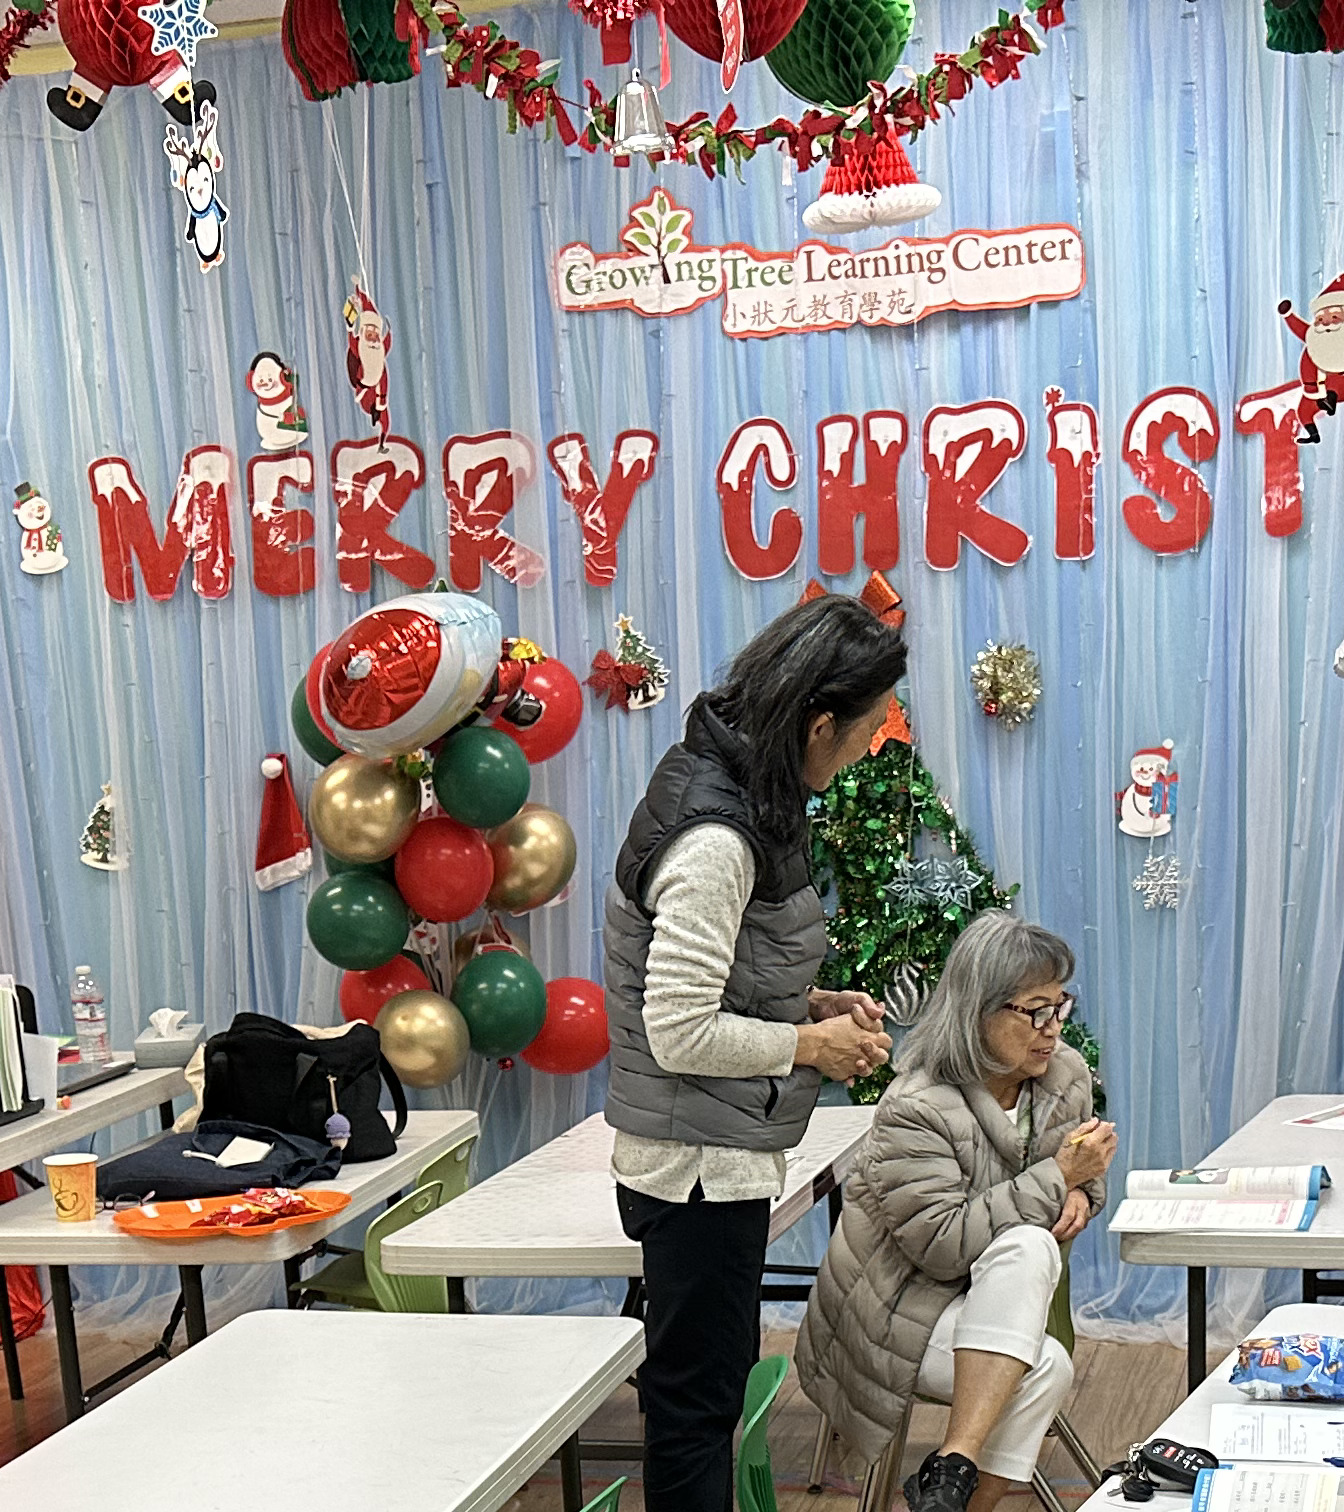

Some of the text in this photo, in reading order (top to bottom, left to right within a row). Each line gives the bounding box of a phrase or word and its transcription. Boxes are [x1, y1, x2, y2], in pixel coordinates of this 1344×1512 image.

[722, 255, 794, 291] Tree
[803, 243, 948, 285] Learning
[952, 233, 1075, 272] Center
[723, 289, 916, 329] 小狀元教育學苑
[88, 427, 658, 602] MERRY
